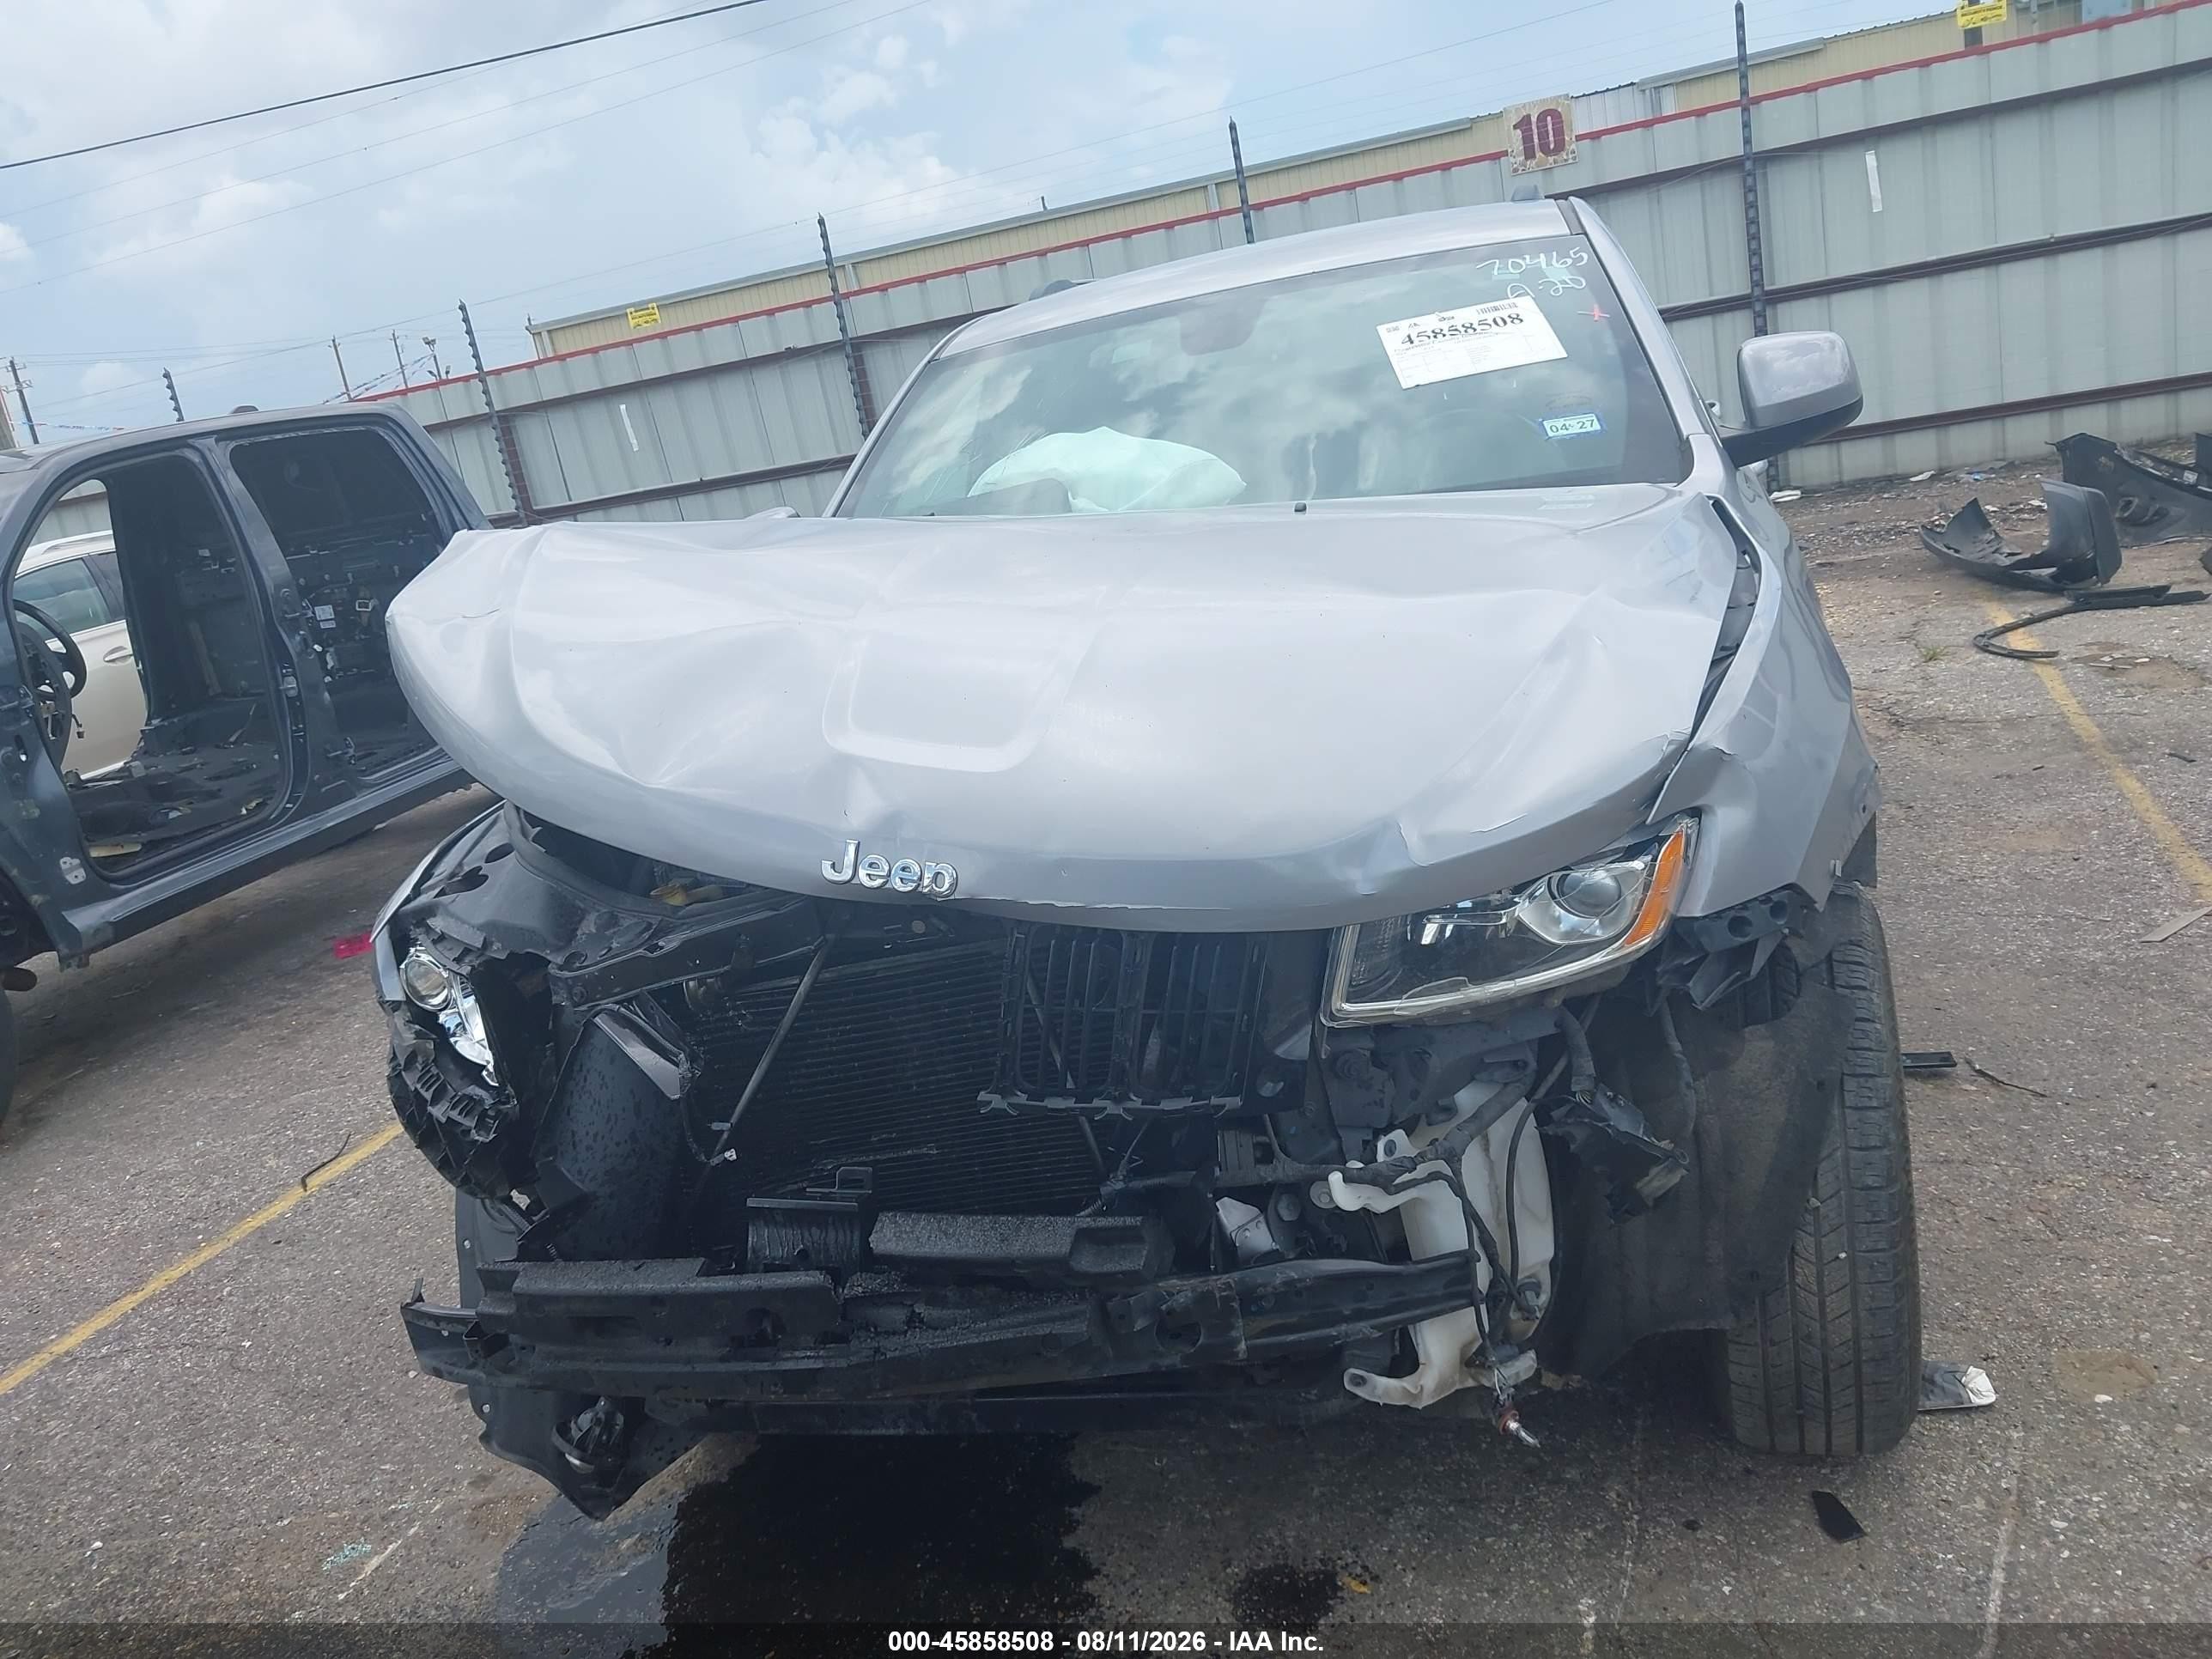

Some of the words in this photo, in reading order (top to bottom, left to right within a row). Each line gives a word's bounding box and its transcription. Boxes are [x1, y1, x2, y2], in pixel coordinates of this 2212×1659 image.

[1512, 108, 1566, 161] 10
[1401, 313, 1524, 345] 45858508
[821, 839, 958, 899] Jeep
